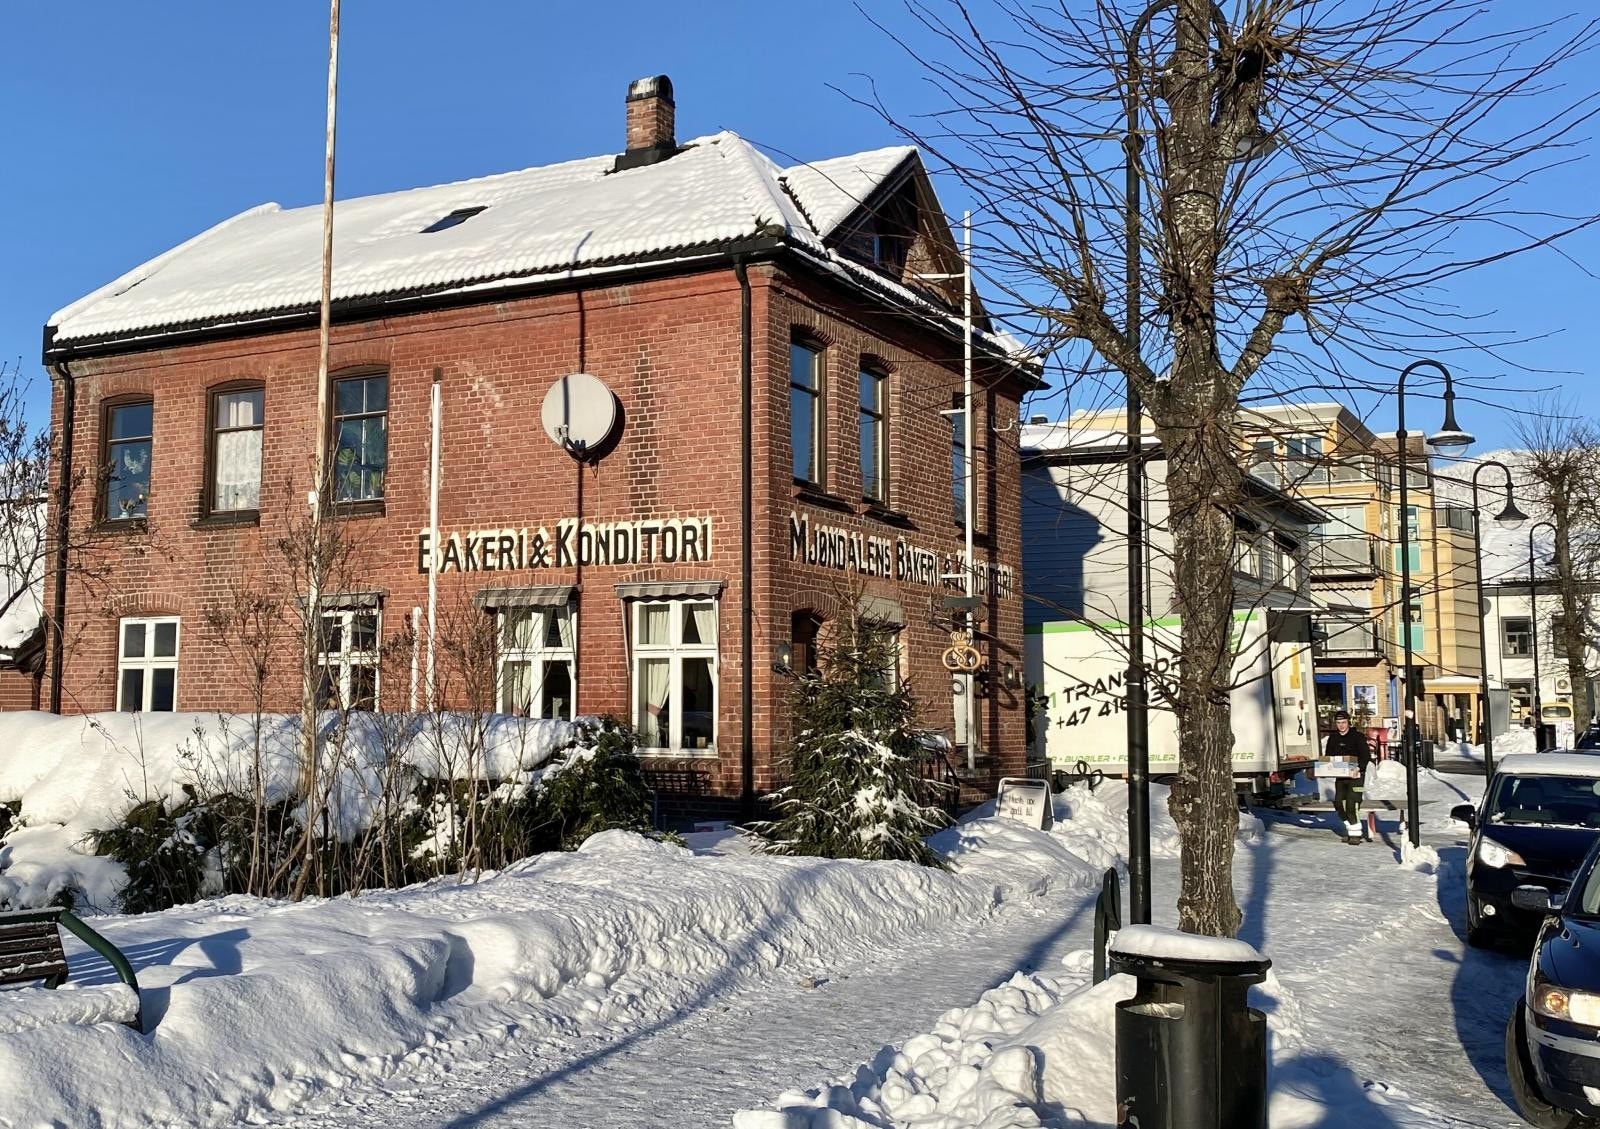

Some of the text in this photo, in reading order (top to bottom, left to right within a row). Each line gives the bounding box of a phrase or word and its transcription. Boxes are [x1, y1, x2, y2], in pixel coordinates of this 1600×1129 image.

[555, 517, 713, 568] KONDITORI
[789, 511, 892, 580] MJØNDALENS
[895, 535, 941, 588] BAKERI
[954, 549, 1014, 601] KNDITORI
[1062, 653, 1182, 704] TRANOR
